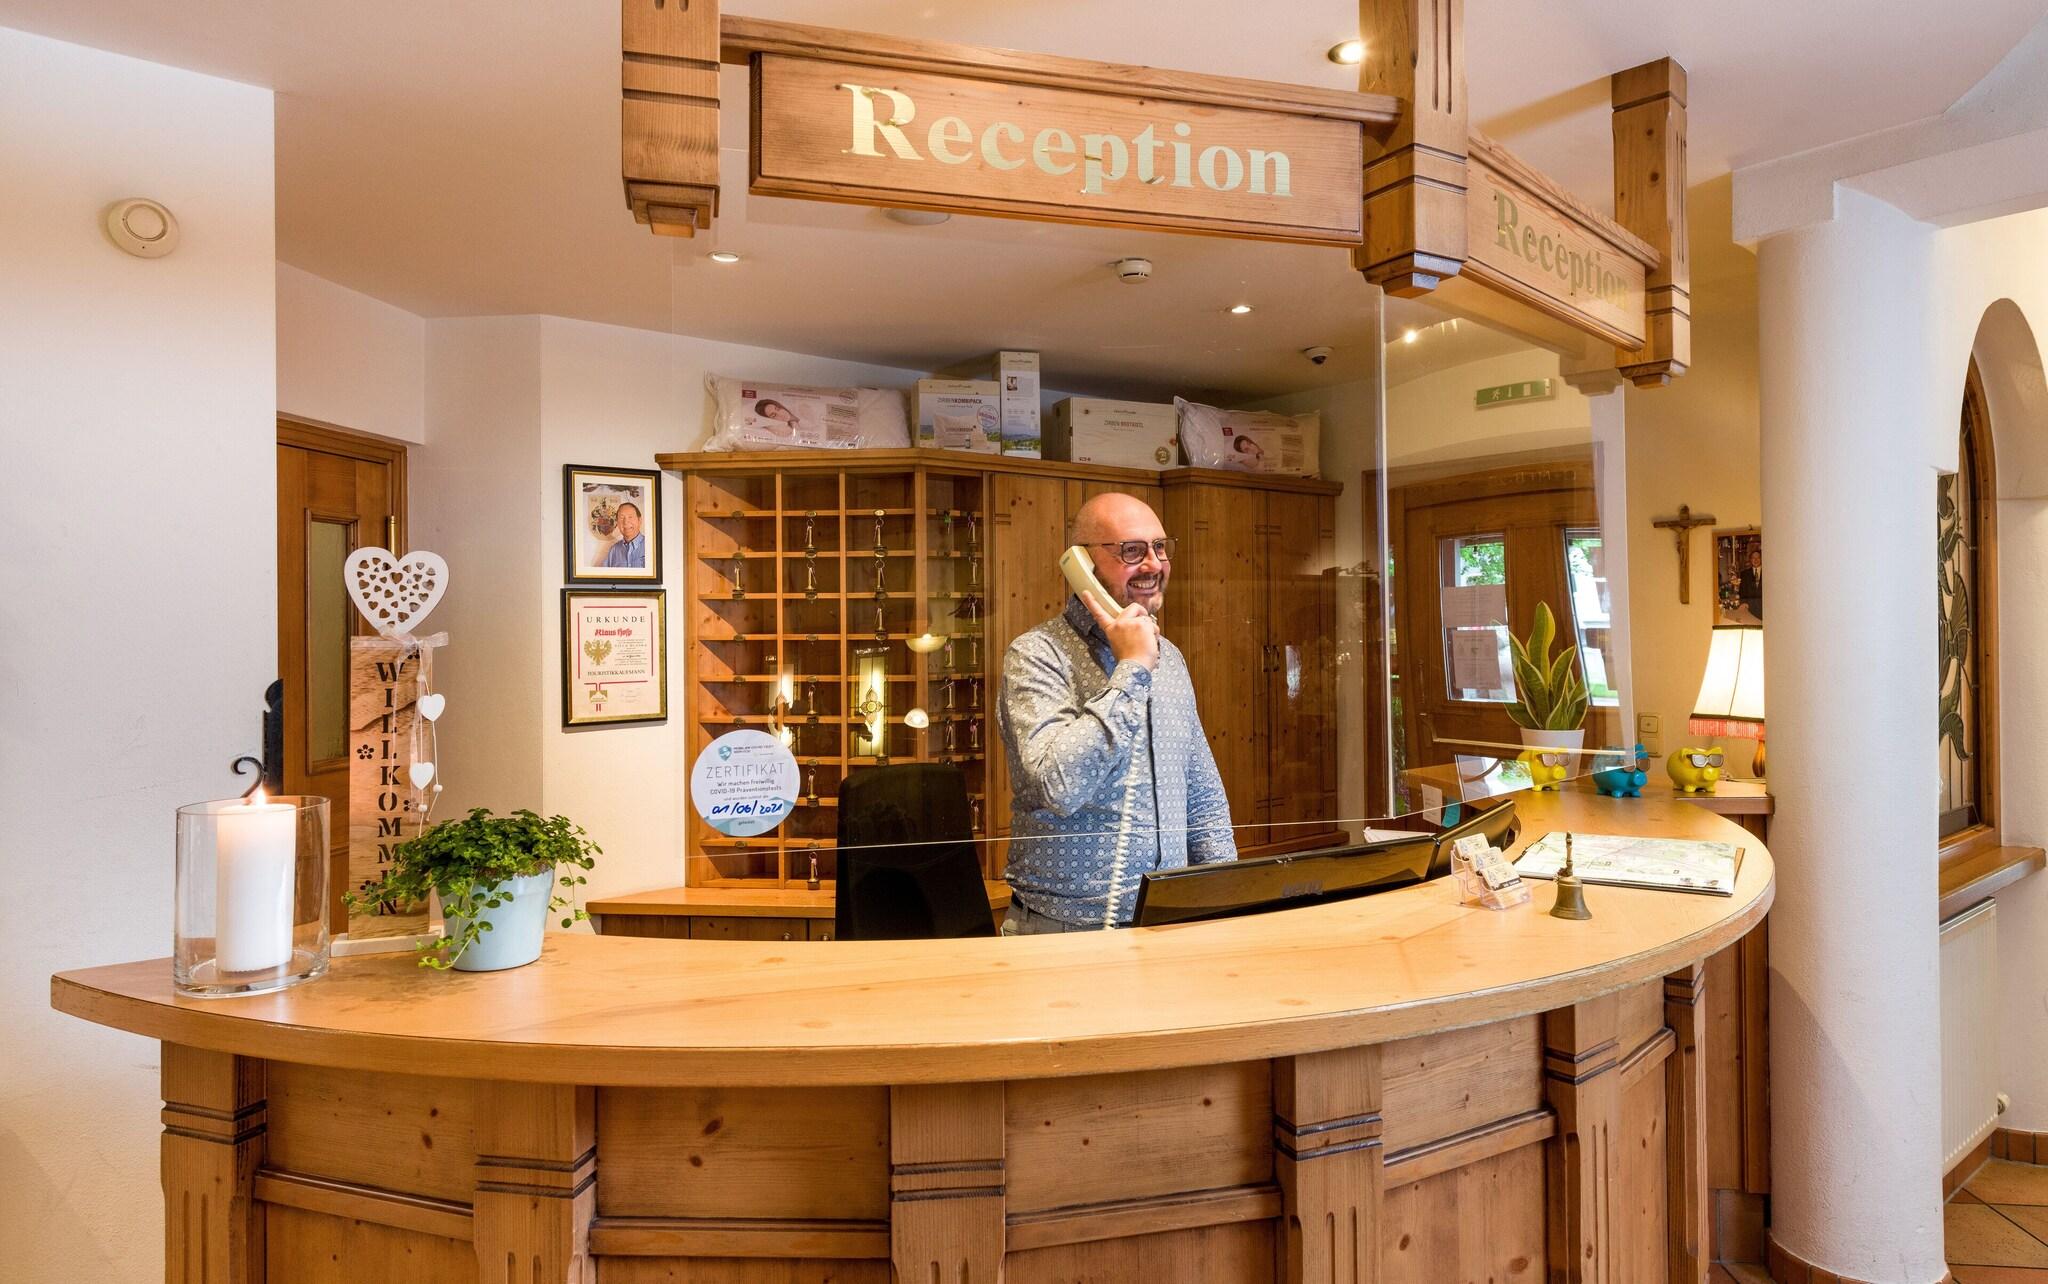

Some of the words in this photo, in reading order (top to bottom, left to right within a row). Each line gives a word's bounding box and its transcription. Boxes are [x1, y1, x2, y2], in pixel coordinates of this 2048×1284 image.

[841, 83, 1294, 198] Reception
[1494, 189, 1630, 312] Reception
[586, 615, 646, 623] URKUNDE
[706, 762, 785, 779] ZERTIFIKAT
[710, 787, 735, 795] COVID-19
